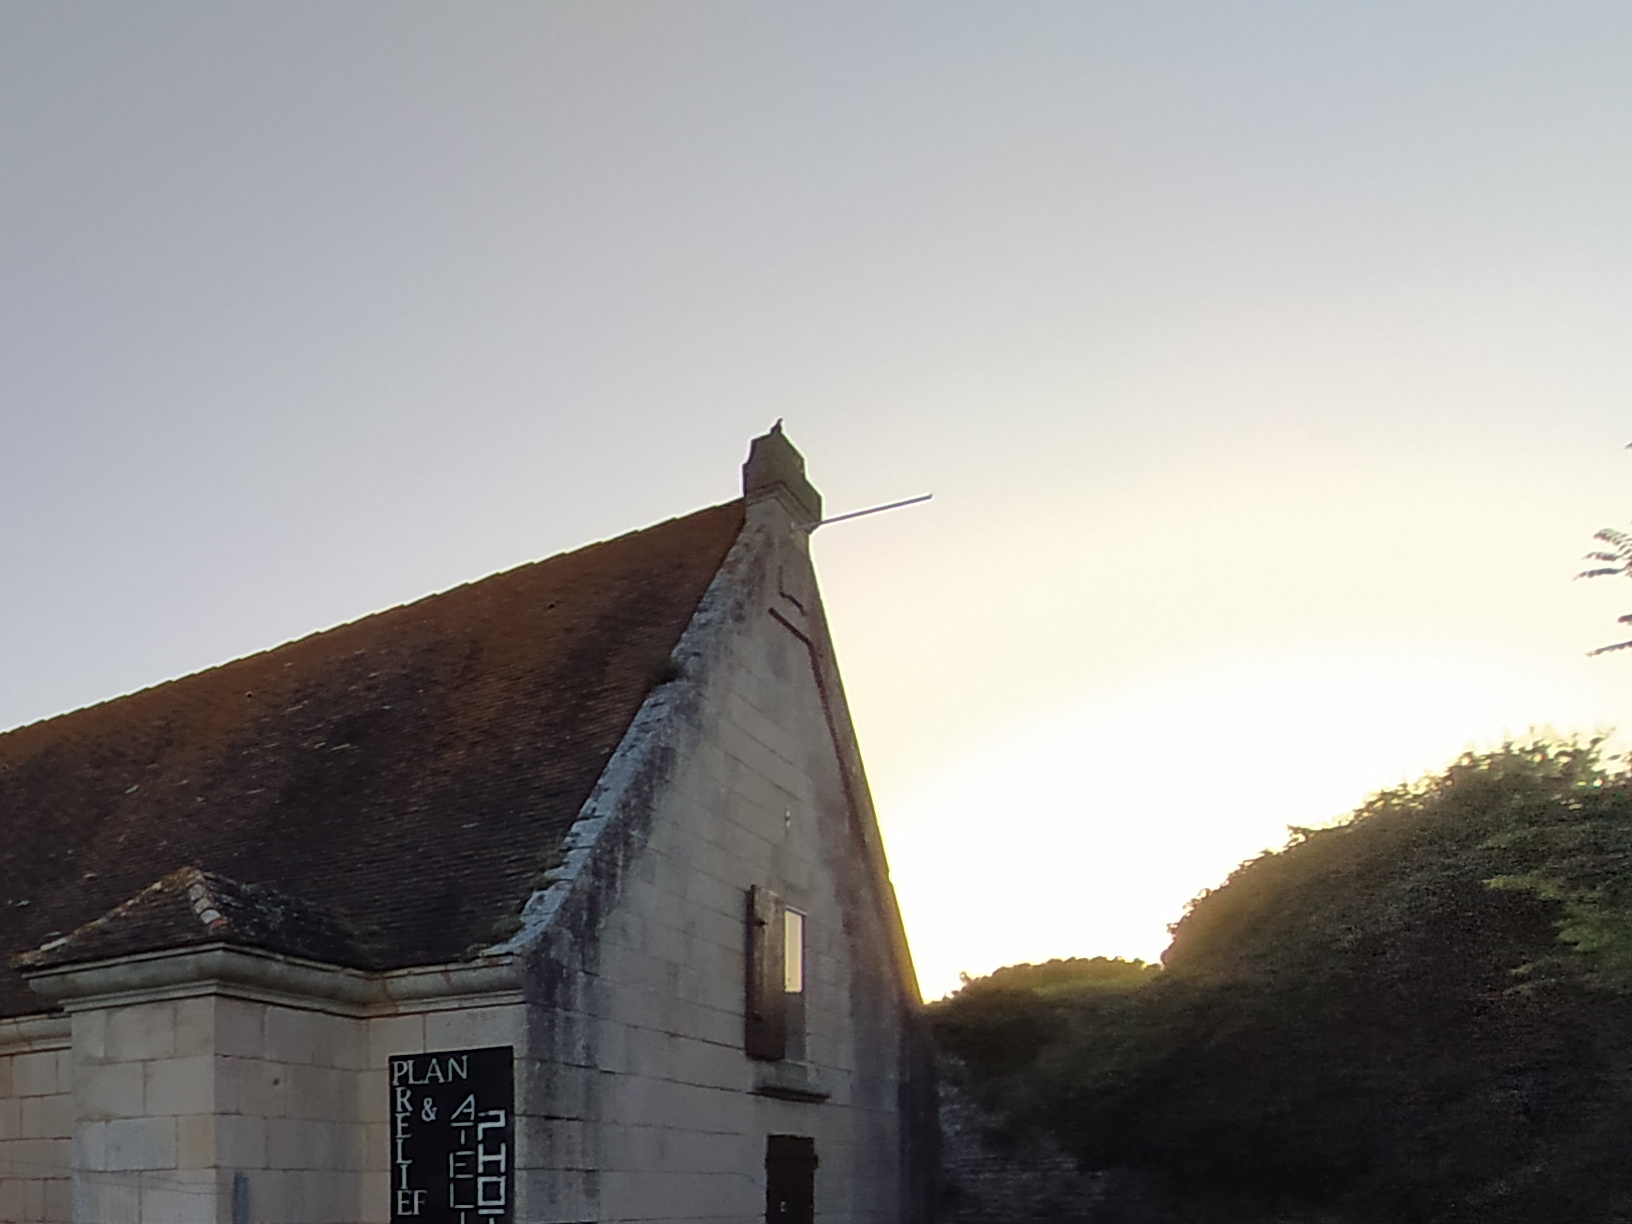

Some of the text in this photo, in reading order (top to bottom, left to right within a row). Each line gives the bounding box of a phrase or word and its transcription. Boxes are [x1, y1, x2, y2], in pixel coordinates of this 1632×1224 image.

[392, 1055, 468, 1085] PLAN
[421, 1097, 437, 1121] &
[395, 1088, 428, 1216] RELIEF
